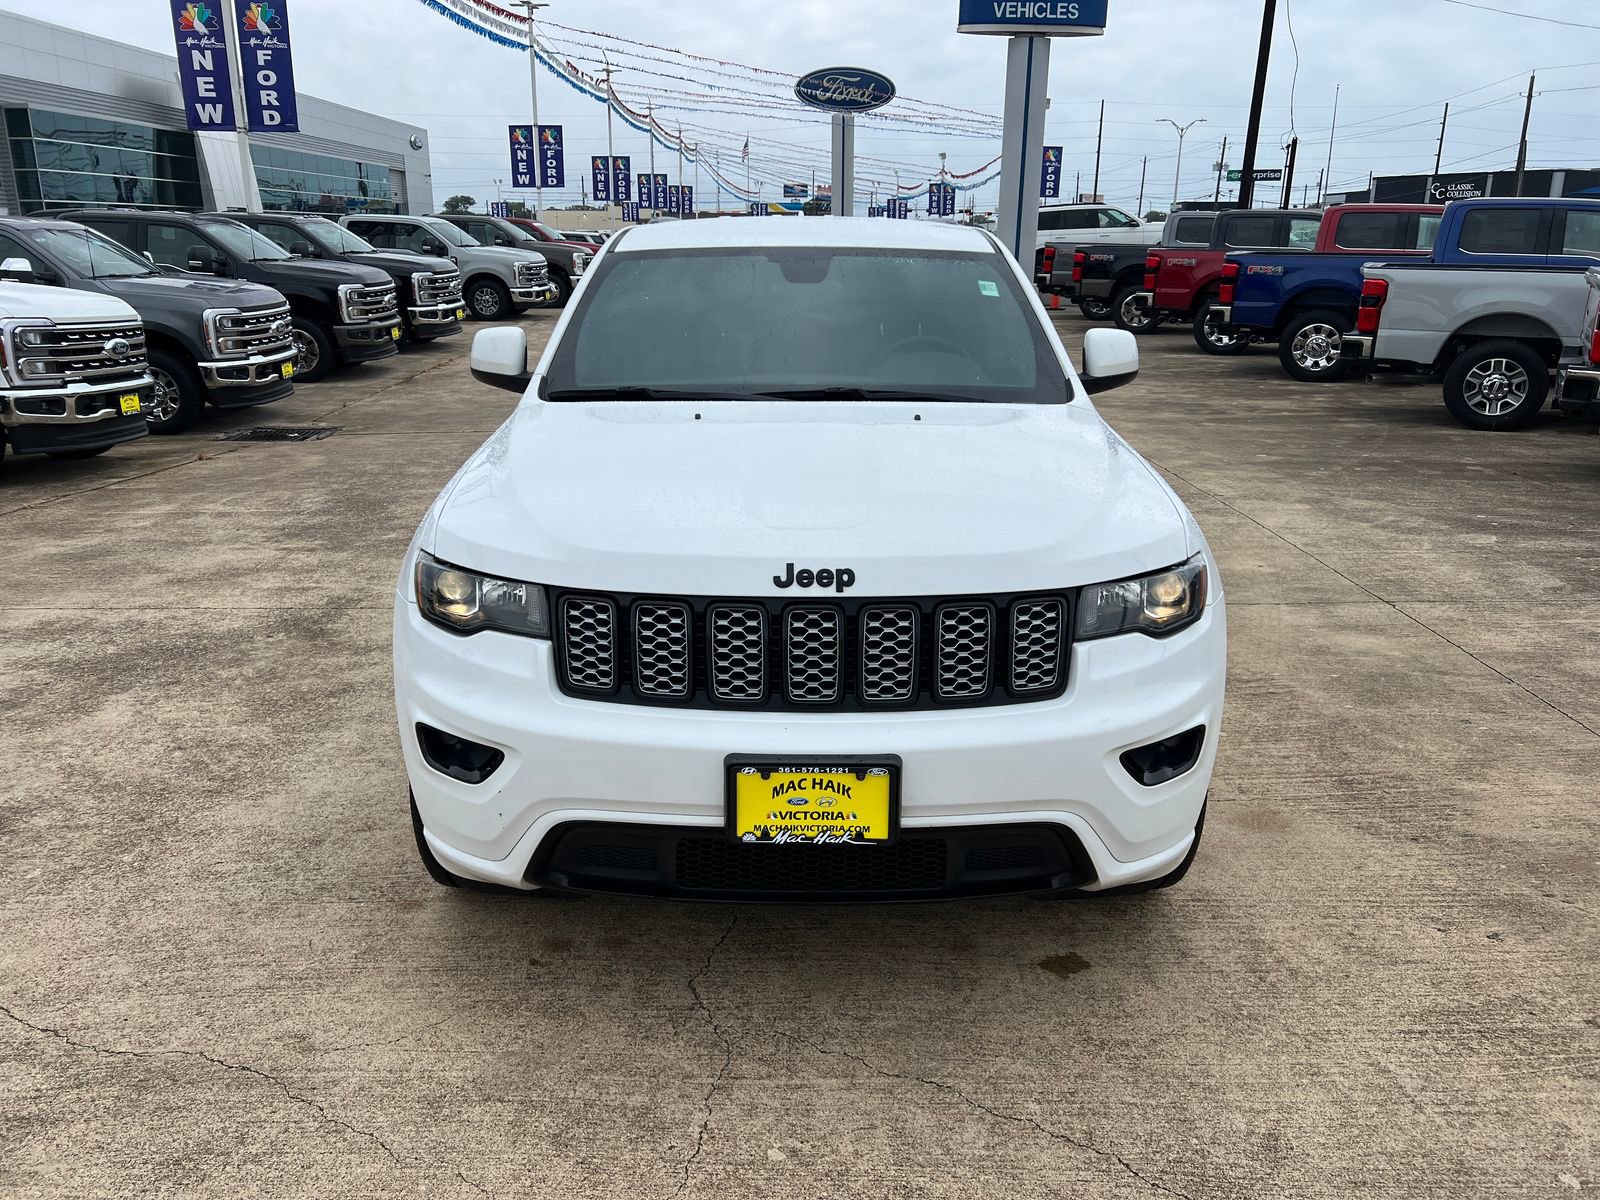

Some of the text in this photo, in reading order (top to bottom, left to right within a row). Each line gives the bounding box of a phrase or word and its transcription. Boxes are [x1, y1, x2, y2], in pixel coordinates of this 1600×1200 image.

[993, 2, 1079, 19] VEHICLES
[191, 49, 223, 124] NEW
[256, 49, 281, 126] FORD
[817, 75, 877, 103] Ford
[517, 150, 530, 185] NEW
[546, 150, 557, 186] FORD
[1229, 171, 1281, 179] erprise
[597, 173, 606, 199] NEW
[617, 173, 626, 200] FORD
[1045, 166, 1055, 196] FORD
[1447, 183, 1475, 191] CLASSIC
[641, 187, 649, 208] NEW
[1446, 190, 1482, 198] COLLISION
[1247, 265, 1284, 276] FX4
[773, 562, 856, 593] Jeep
[771, 777, 852, 800] MAC HAIK
[789, 797, 807, 805] Ford
[779, 811, 845, 821] VICTORIA
[772, 829, 856, 845] Mac Haik
